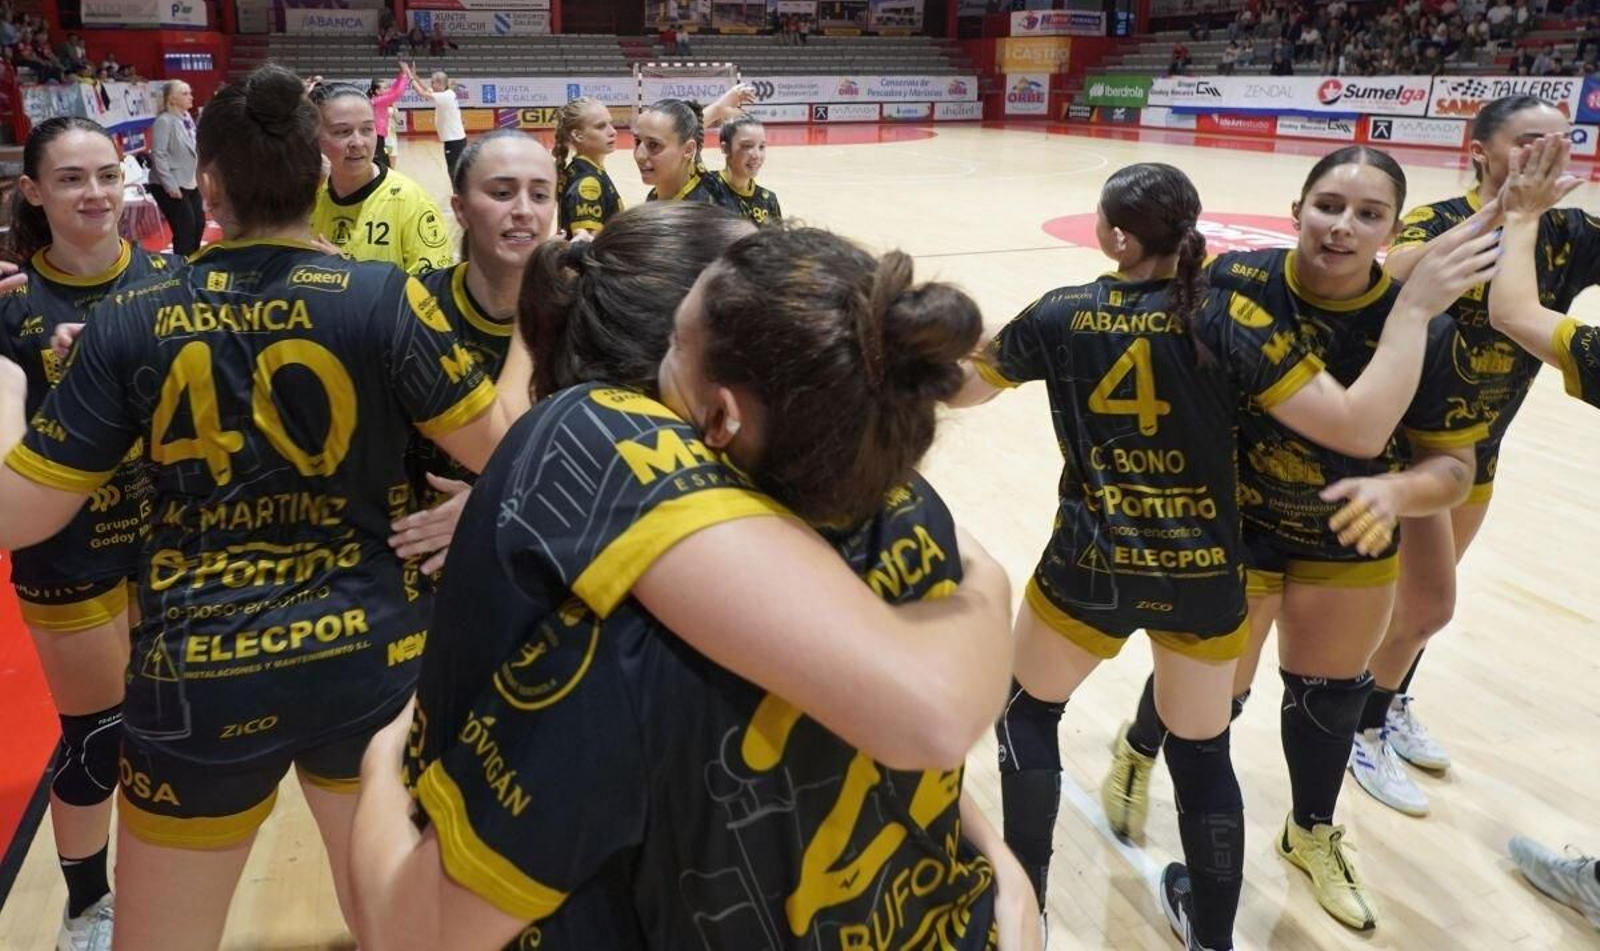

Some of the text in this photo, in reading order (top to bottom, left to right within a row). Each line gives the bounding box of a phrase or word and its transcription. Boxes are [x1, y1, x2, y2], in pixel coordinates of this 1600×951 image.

[434, 12, 466, 22] XUNTA
[448, 22, 486, 32] GALICIA
[499, 85, 530, 93] XUNTA
[584, 85, 611, 93] XUNTA
[919, 79, 929, 87] de
[1491, 81, 1574, 101] TALLERES
[513, 94, 547, 103] GALICIA
[1007, 92, 1046, 103] ORBE
[1104, 85, 1144, 98] Iberdrola
[1243, 85, 1294, 98] ZENDAL
[1343, 84, 1426, 105] Sumelga
[365, 220, 390, 246] 12
[19, 327, 44, 337] ZICO
[1087, 337, 1171, 437] 4
[151, 338, 358, 487] 40
[1090, 446, 1186, 474] C. BONO
[95, 517, 139, 533] Grupo
[89, 532, 135, 549] Godoy
[1114, 546, 1227, 569] ELECPOR
[1135, 600, 1174, 612] ZICO
[184, 608, 369, 663] ELECPOR
[183, 661, 262, 680] INSTALACIONES
[264, 661, 271, 669] Y
[273, 643, 353, 668] MANTENIMIENTO
[219, 714, 278, 739] ZICO
